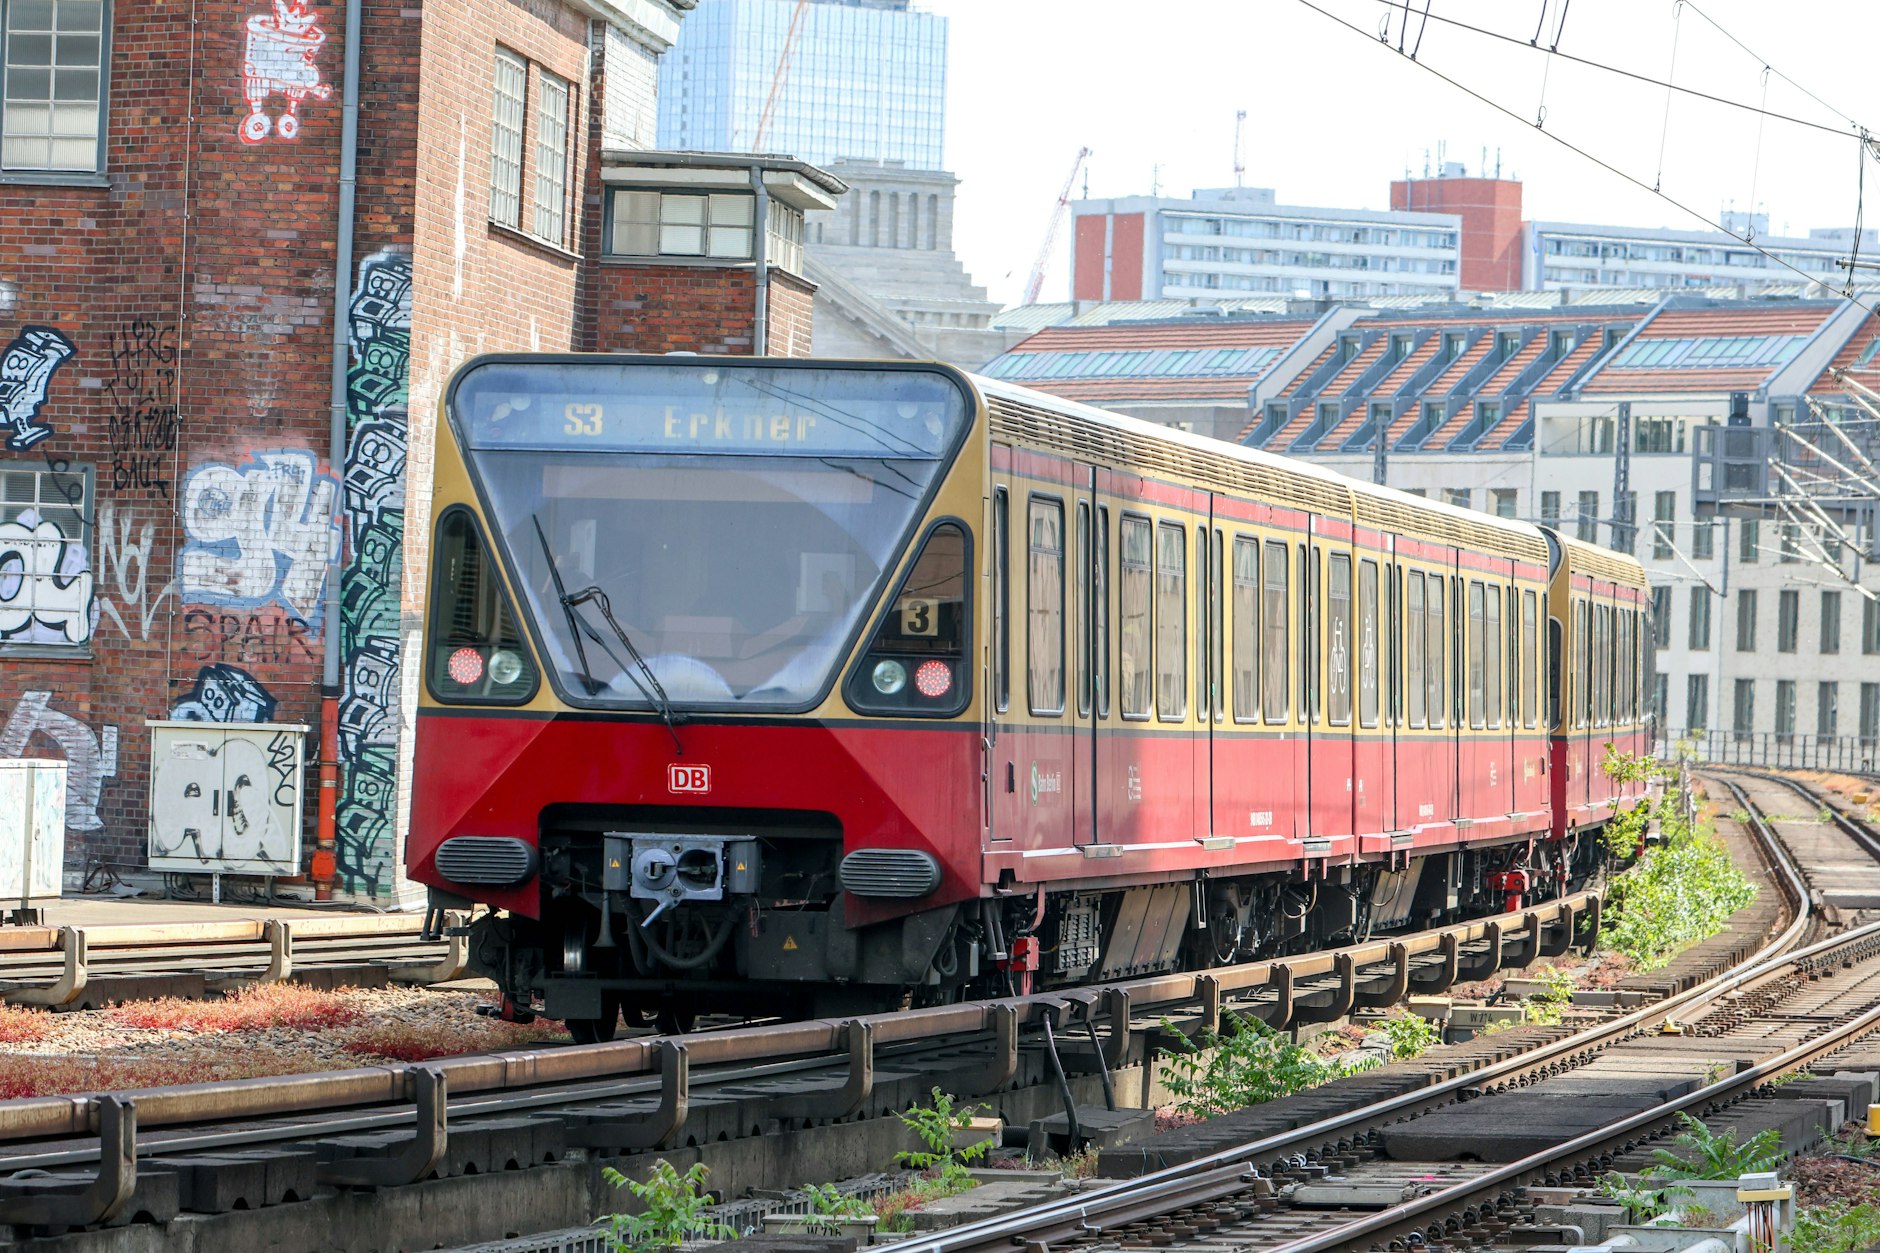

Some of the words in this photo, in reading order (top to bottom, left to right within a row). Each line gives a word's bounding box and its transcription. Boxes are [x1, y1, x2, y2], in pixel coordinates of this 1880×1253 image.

[564, 403, 603, 436] S3
[664, 405, 816, 441] Erkner
[907, 600, 930, 633] 3
[674, 768, 706, 789] DB
